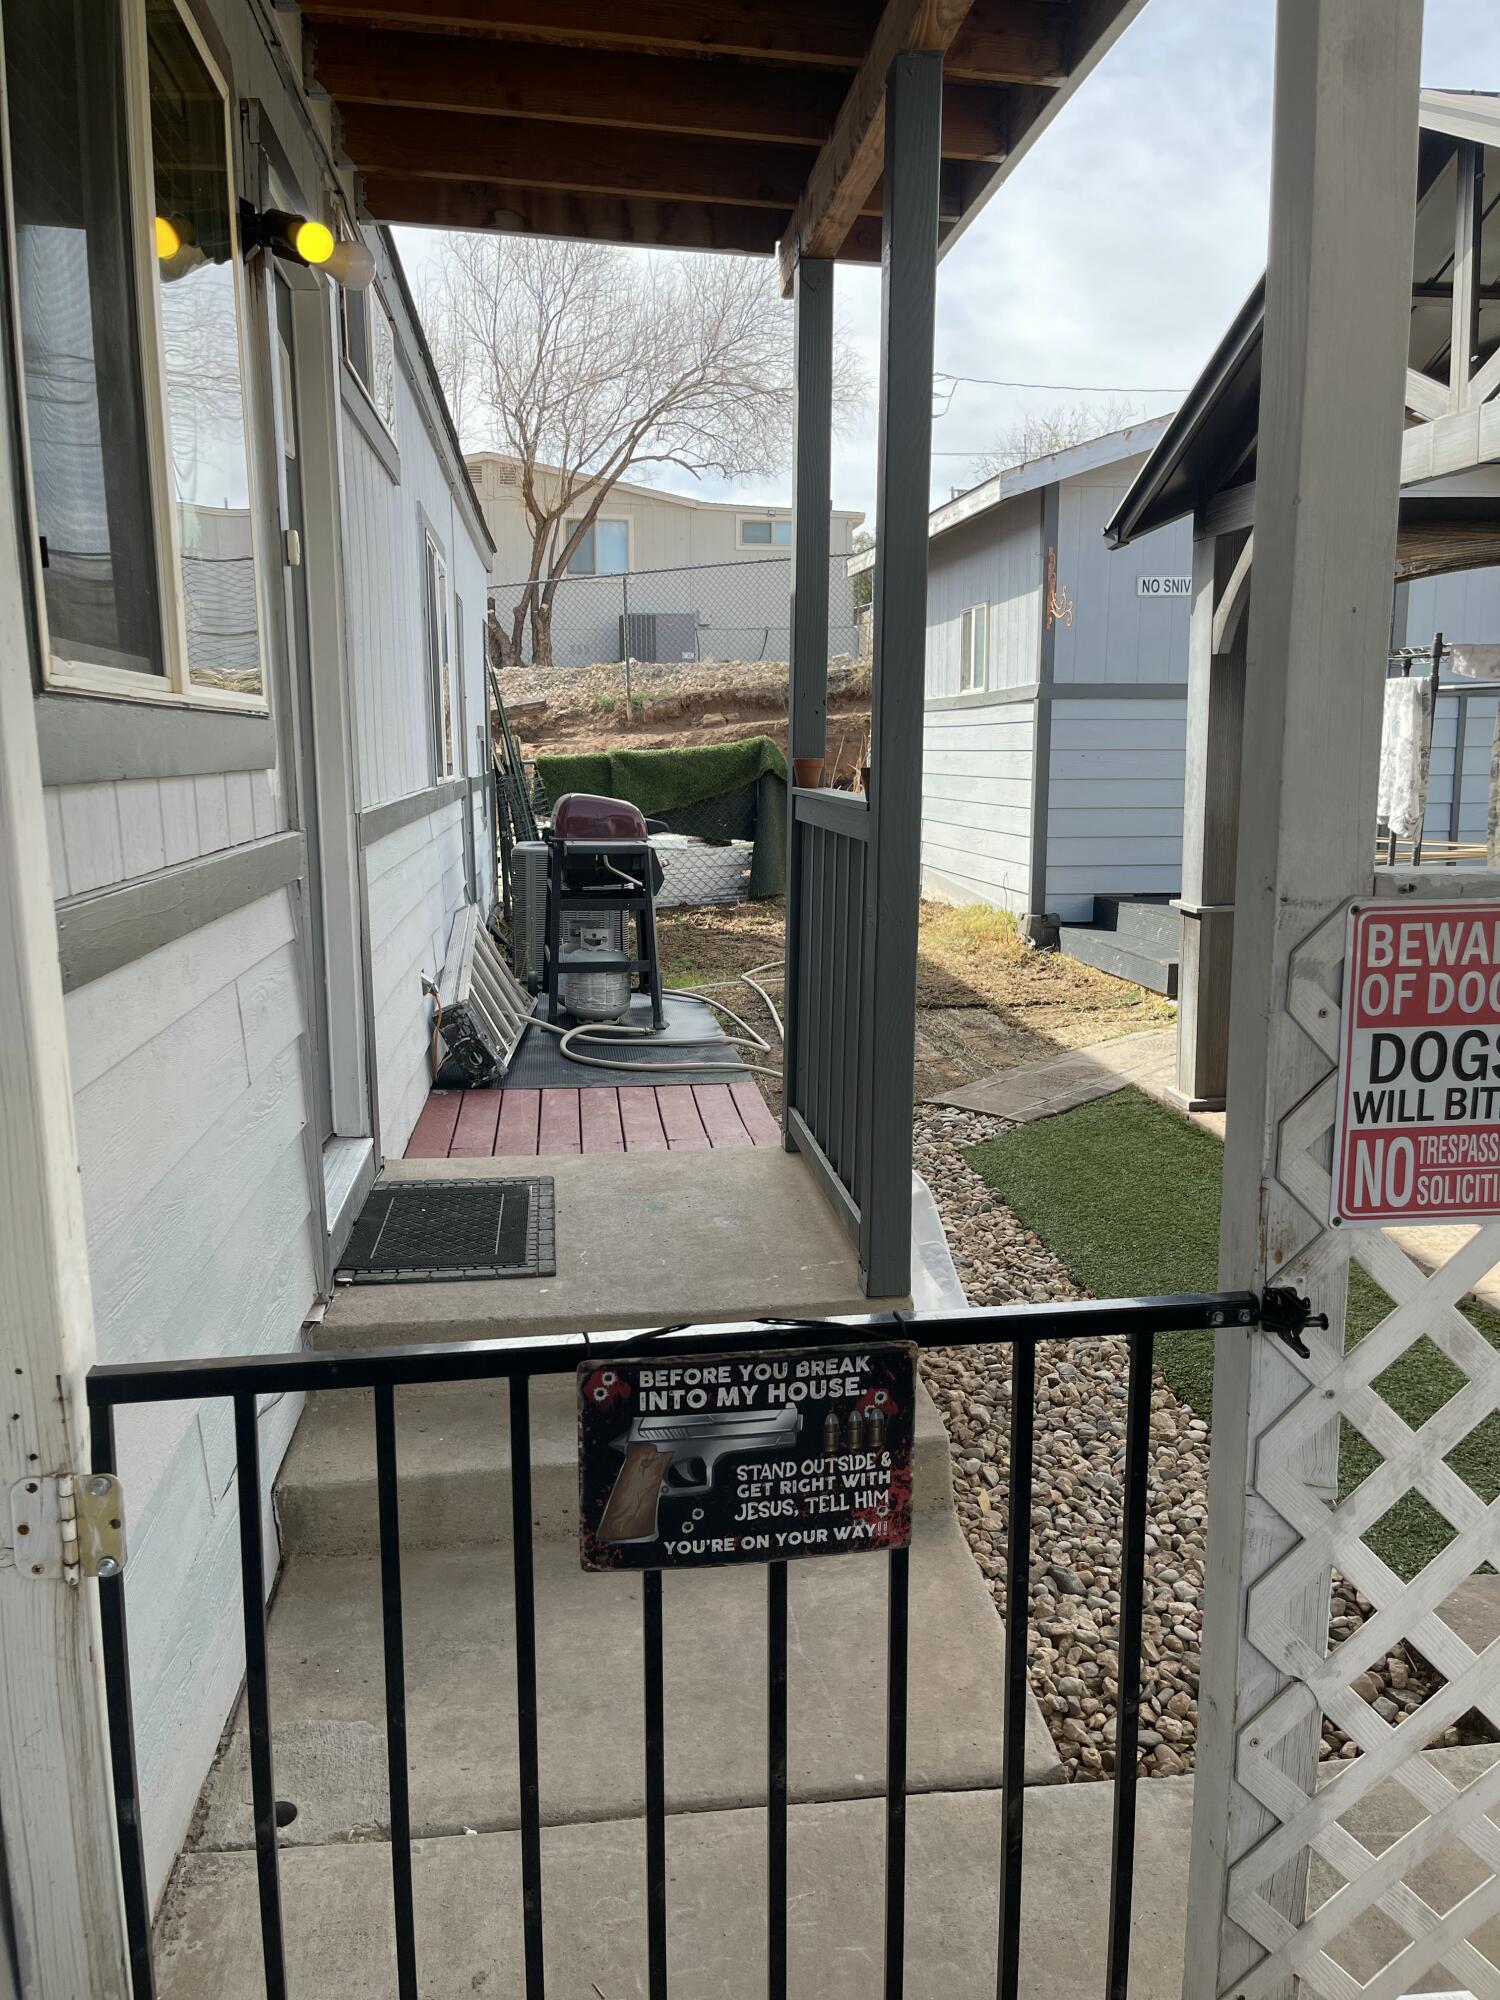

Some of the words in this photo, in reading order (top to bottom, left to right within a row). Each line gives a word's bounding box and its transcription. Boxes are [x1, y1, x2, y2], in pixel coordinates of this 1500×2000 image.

[1142, 579, 1160, 593] NO
[1361, 973, 1416, 1017] OF
[1353, 1089, 1434, 1124] WILL
[1444, 1086, 1500, 1121] BIT
[1353, 1136, 1415, 1208] NO
[1418, 1132, 1500, 1165] TRESPASS
[1416, 1173, 1500, 1206] SOLICITI
[639, 1367, 732, 1388] BEFORE
[738, 1362, 788, 1382] YOU
[795, 1355, 871, 1378] BREAK
[639, 1388, 708, 1412] INTO
[716, 1384, 759, 1408] MY
[767, 1376, 868, 1404] HOUSE.
[736, 1461, 798, 1482] STAND
[800, 1452, 877, 1476] OUTSIDE
[880, 1451, 892, 1468] &
[736, 1481, 774, 1499] GET
[779, 1475, 837, 1495] RIGHT
[841, 1470, 891, 1489] WITH
[734, 1498, 800, 1522] JESUS,
[804, 1493, 851, 1514] TELL
[854, 1489, 890, 1510] HIM
[663, 1537, 735, 1556] YOU'RE
[740, 1534, 770, 1550] ON
[775, 1528, 828, 1547] YOUR
[832, 1520, 889, 1541] WAY!!
